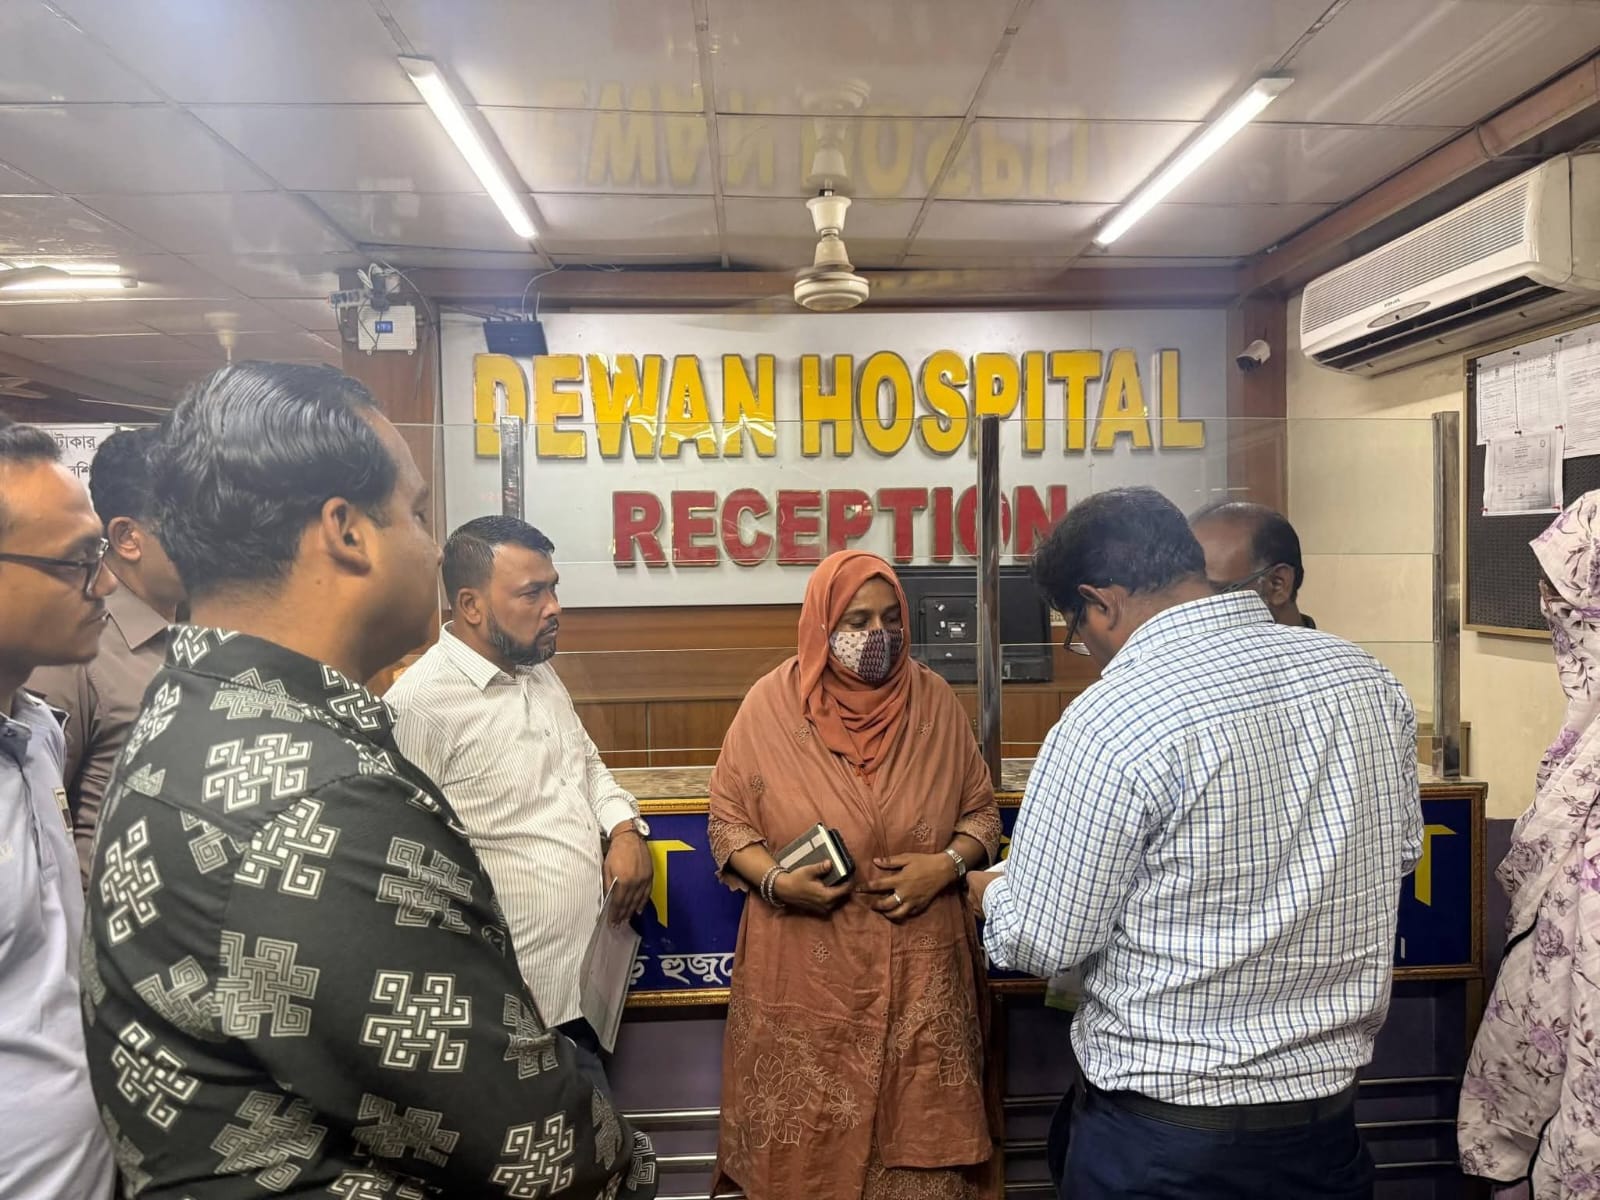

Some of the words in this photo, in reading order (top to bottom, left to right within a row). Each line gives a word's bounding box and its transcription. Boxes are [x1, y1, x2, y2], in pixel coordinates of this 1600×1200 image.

[473, 353, 777, 459] DEWAN
[800, 348, 1206, 458] HOSPITAL
[612, 484, 1069, 567] RECEPTION
